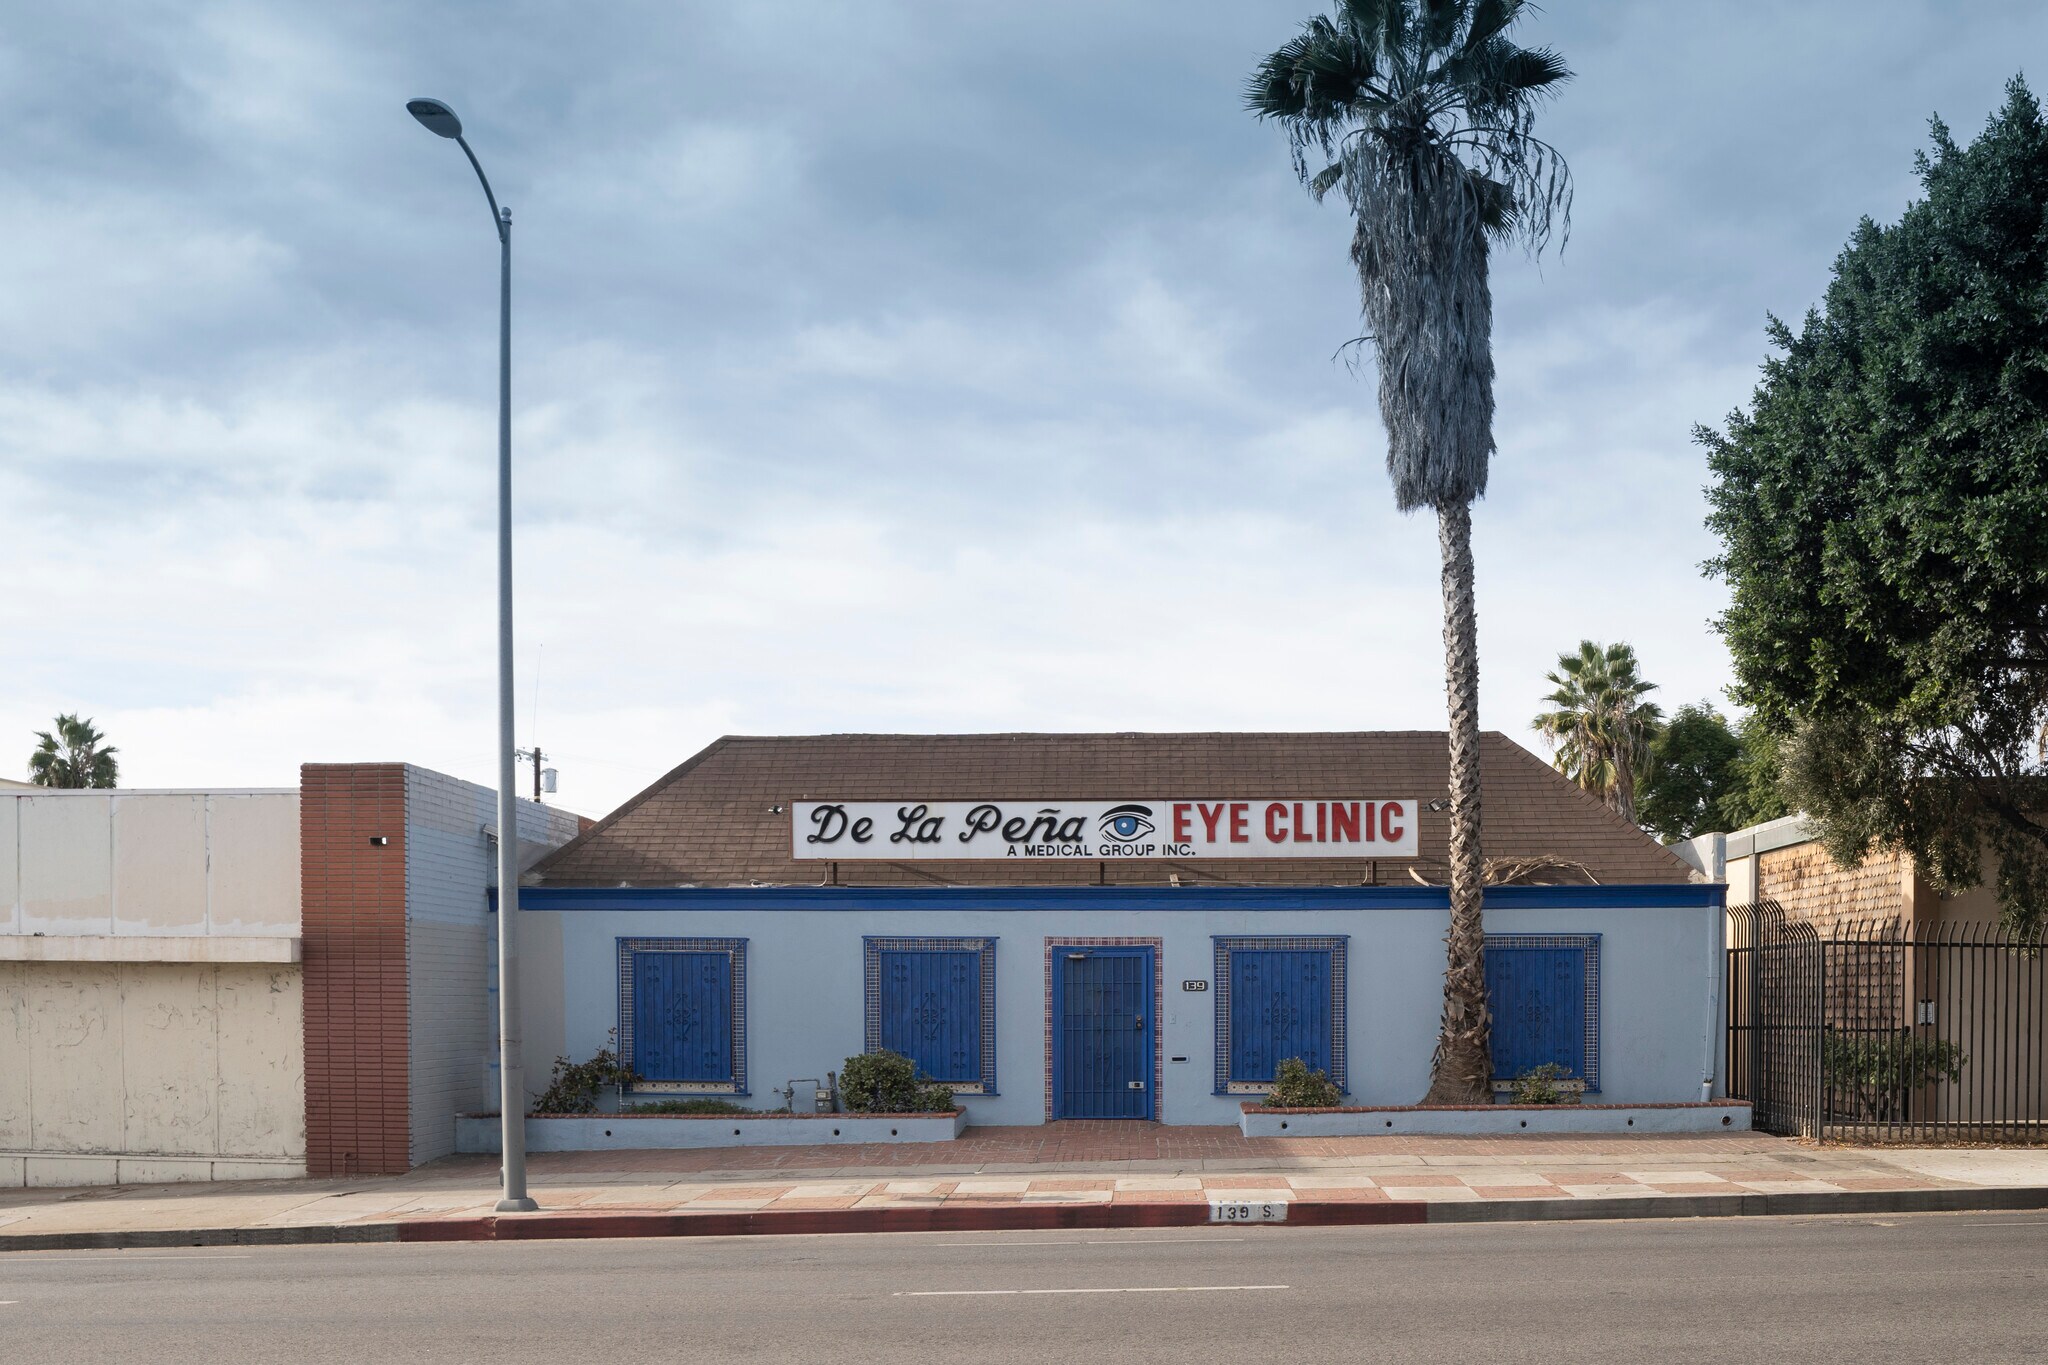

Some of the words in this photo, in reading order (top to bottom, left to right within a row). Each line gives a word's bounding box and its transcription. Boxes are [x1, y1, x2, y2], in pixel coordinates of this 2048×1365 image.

[806, 804, 874, 844] De
[890, 804, 946, 844] La
[958, 804, 1088, 844] Peña
[1173, 803, 1249, 844] EYE
[1265, 802, 1404, 844] CLINIC
[1006, 844, 1018, 857] A
[1024, 844, 1093, 857] MEDICAL
[1099, 843, 1156, 857] GROUP
[1162, 843, 1197, 857] INC.
[1185, 981, 1205, 991] 139
[1217, 1206, 1249, 1220] 139
[1262, 1205, 1275, 1218] S.
